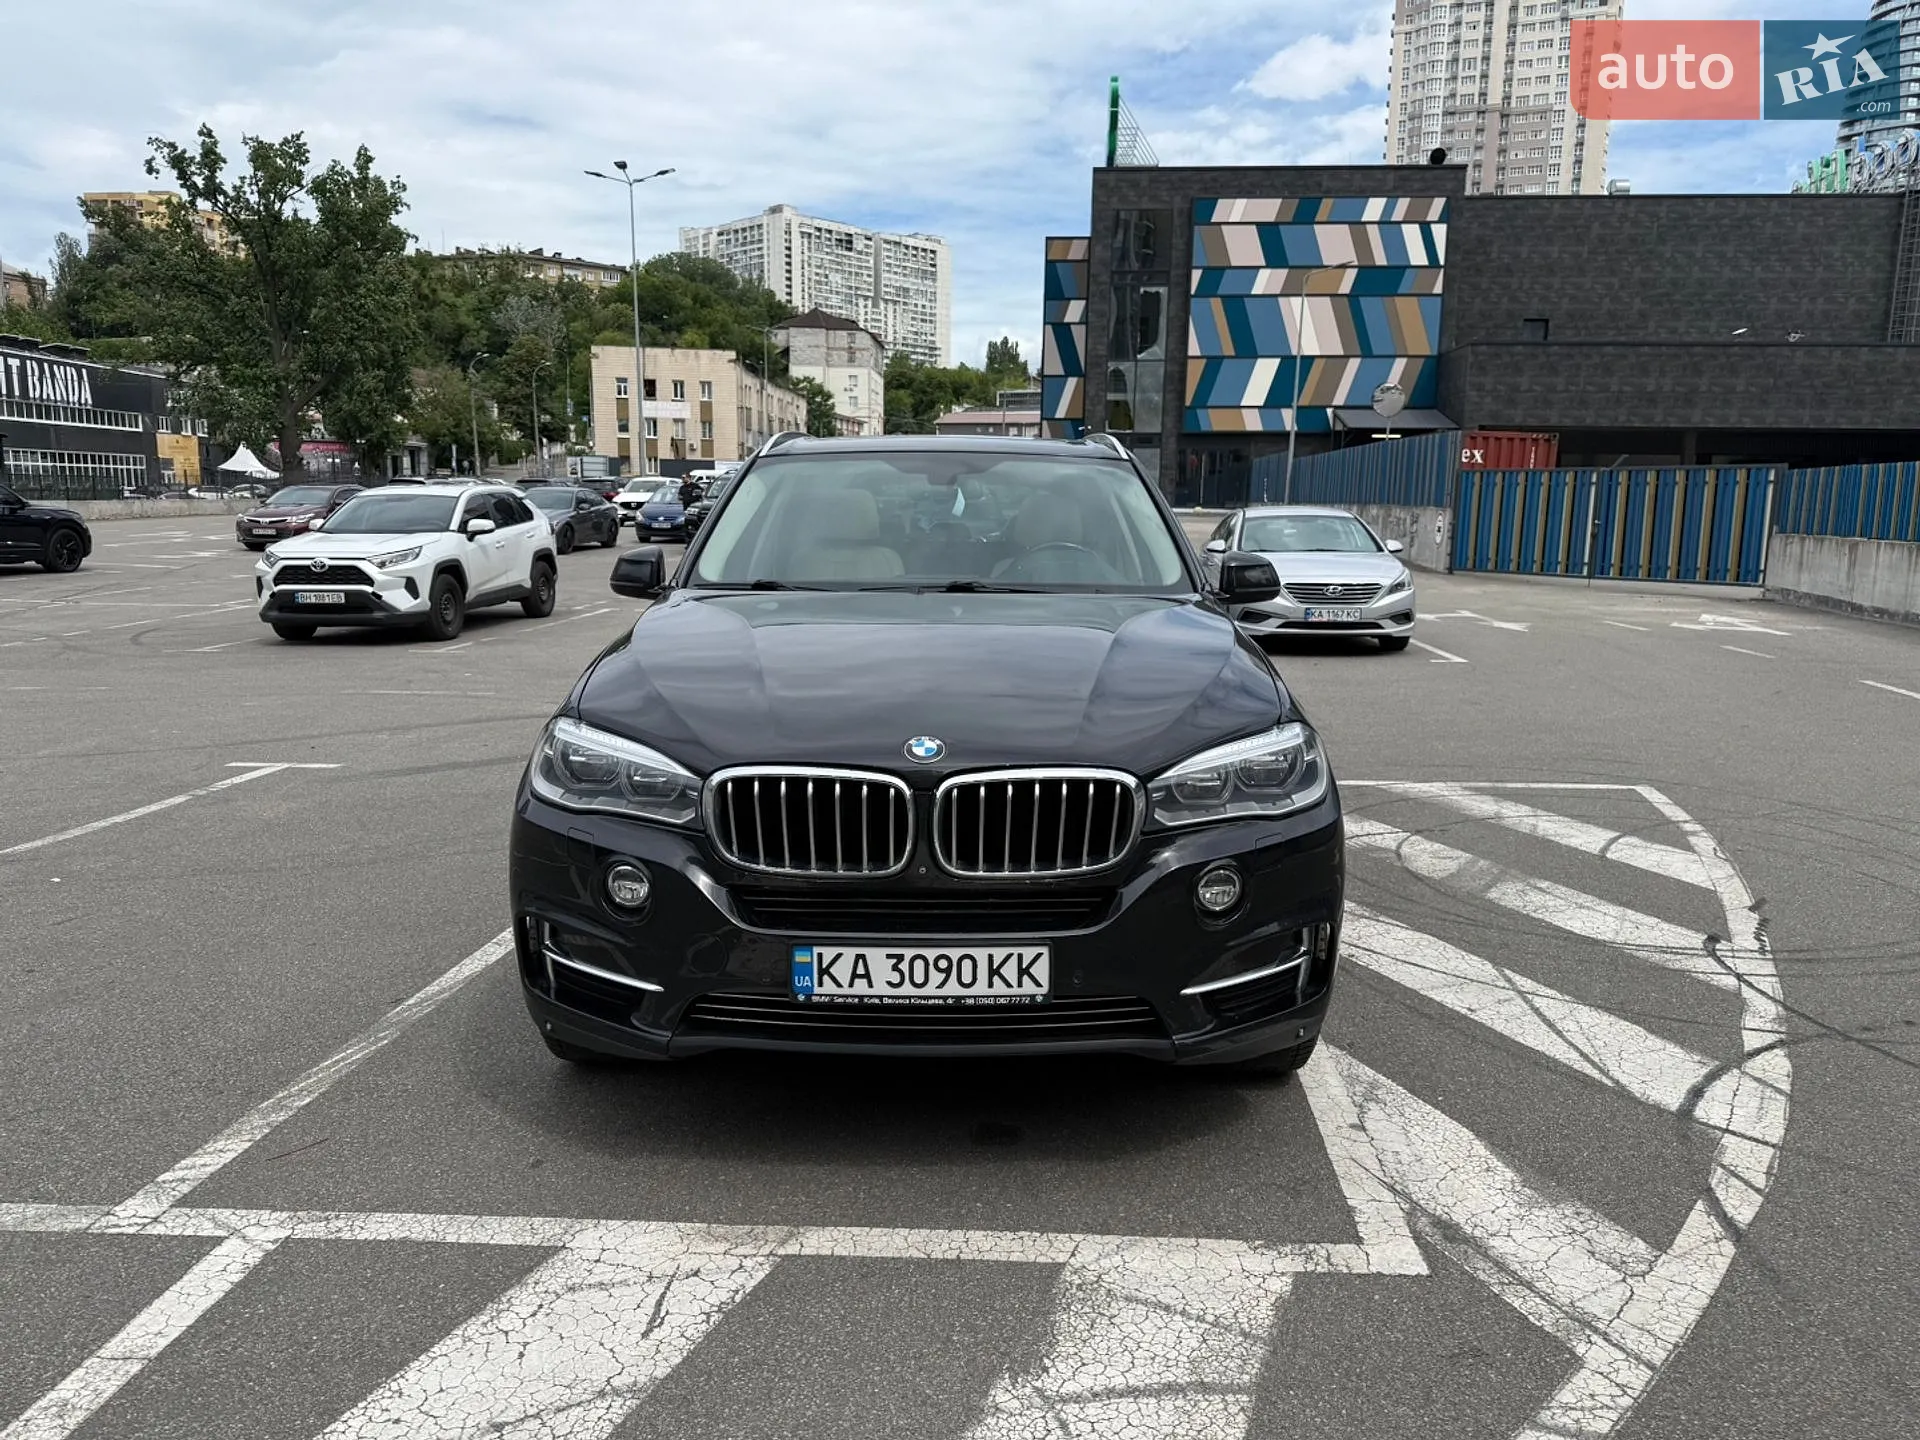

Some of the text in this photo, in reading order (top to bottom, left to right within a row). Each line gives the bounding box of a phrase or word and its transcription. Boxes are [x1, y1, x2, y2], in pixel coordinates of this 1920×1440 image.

[26, 359, 93, 404] BANDA
[794, 975, 812, 987] UA
[817, 951, 1044, 989] KA 3090 KK
